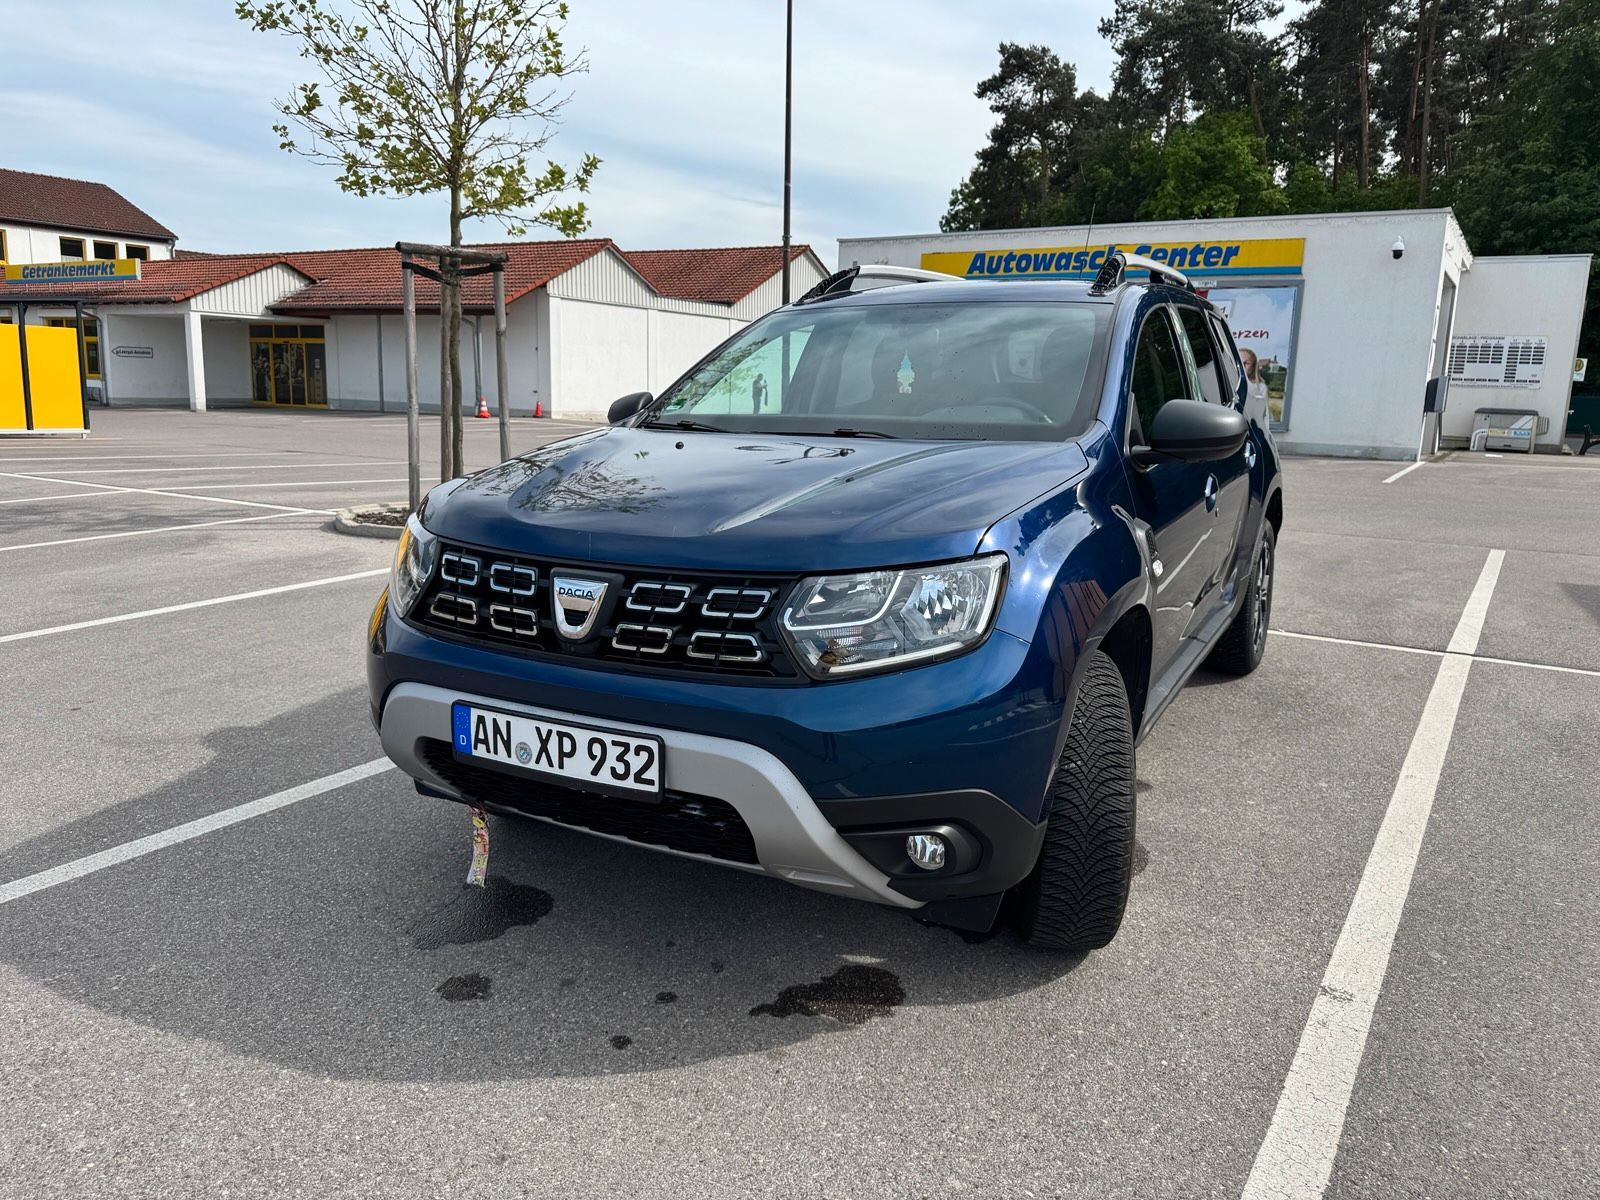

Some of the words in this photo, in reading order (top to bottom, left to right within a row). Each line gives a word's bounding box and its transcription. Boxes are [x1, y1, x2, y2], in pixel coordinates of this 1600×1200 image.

[22, 262, 115, 278] Getränkemarkt
[1232, 330, 1269, 339] erzen
[558, 587, 594, 598] DACIA
[460, 735, 467, 745] D
[473, 715, 512, 758] AN
[534, 726, 577, 769] XP
[587, 737, 655, 786] 932
